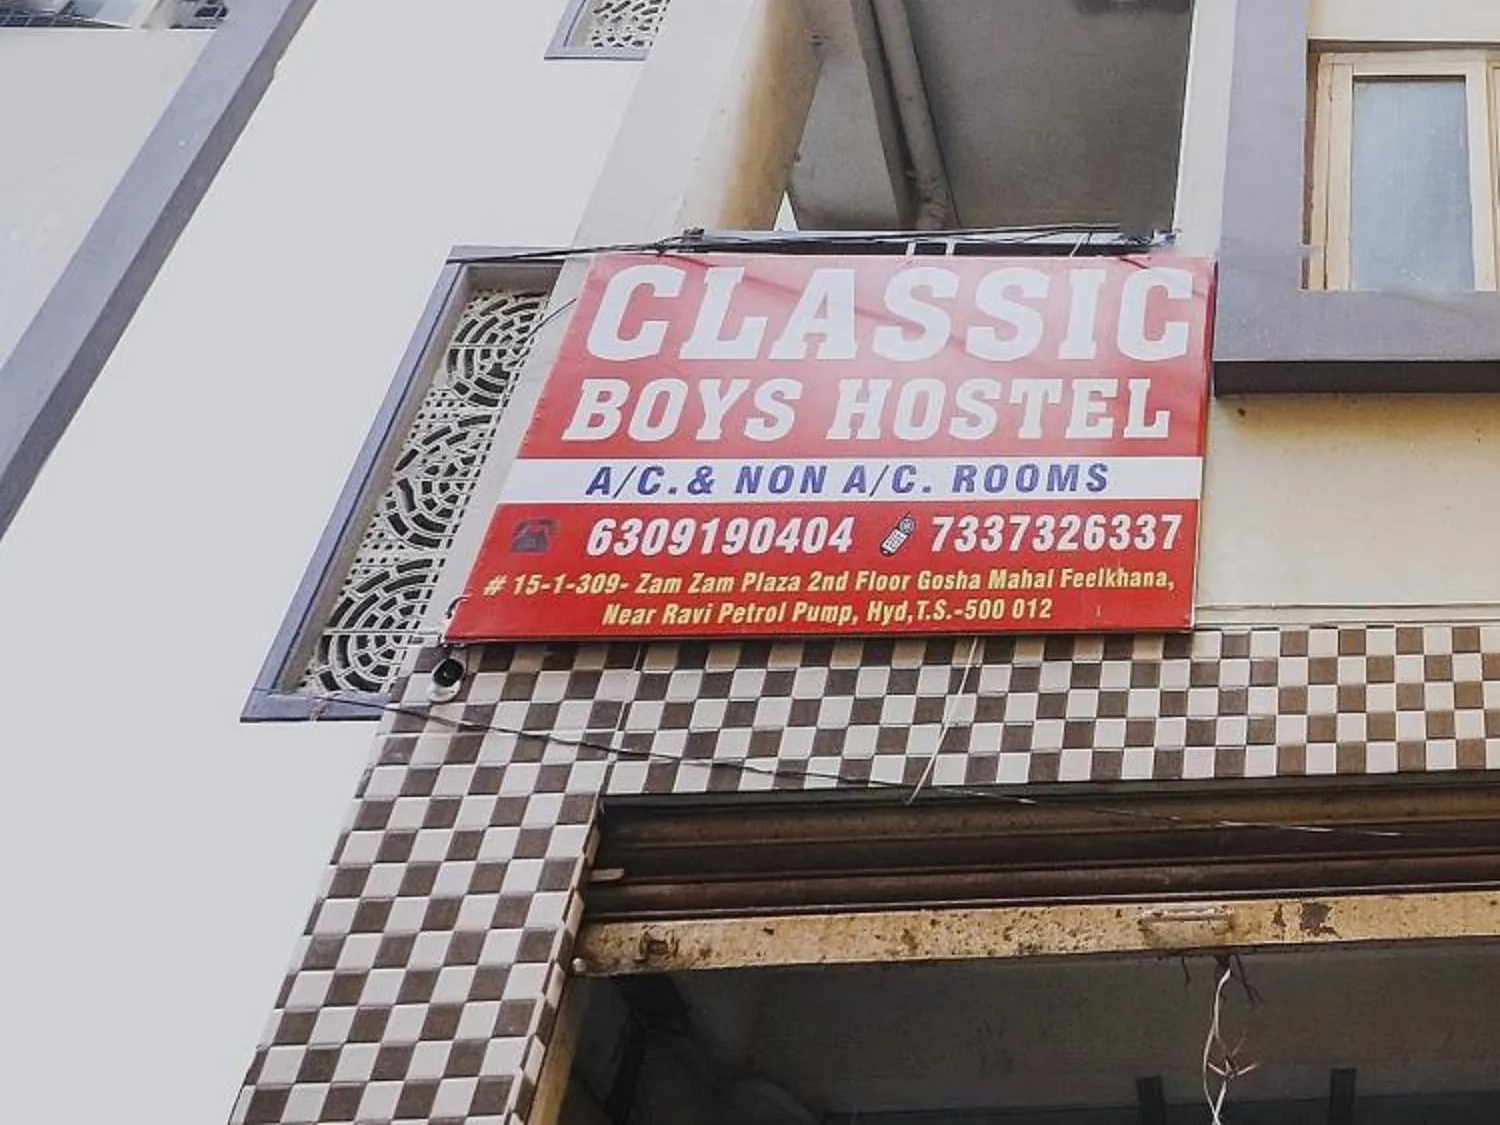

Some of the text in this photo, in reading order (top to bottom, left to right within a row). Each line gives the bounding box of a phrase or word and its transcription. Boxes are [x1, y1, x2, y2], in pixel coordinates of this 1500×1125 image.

[585, 265, 1194, 363] CLASSIC
[562, 377, 1170, 444] BOYS HOSTEL
[735, 465, 827, 494] NON
[843, 465, 931, 497] A/C.
[951, 463, 1109, 494] ROOMS
[586, 513, 1182, 556] 6309190404 7337326337
[483, 575, 506, 595] #
[513, 573, 628, 595] 15-1-309-
[634, 572, 679, 594] Zam
[687, 572, 733, 594] Zam
[741, 571, 800, 592] Plaza
[807, 571, 847, 592] 2nd
[854, 571, 911, 591] Floor
[918, 570, 981, 590] Gosha
[1060, 567, 1175, 591] Feelkhana,
[602, 604, 656, 626] Near
[661, 604, 710, 625] Ravi
[717, 603, 785, 625] Petrol
[794, 603, 858, 626] Pump,
[1012, 598, 1053, 619] 012
